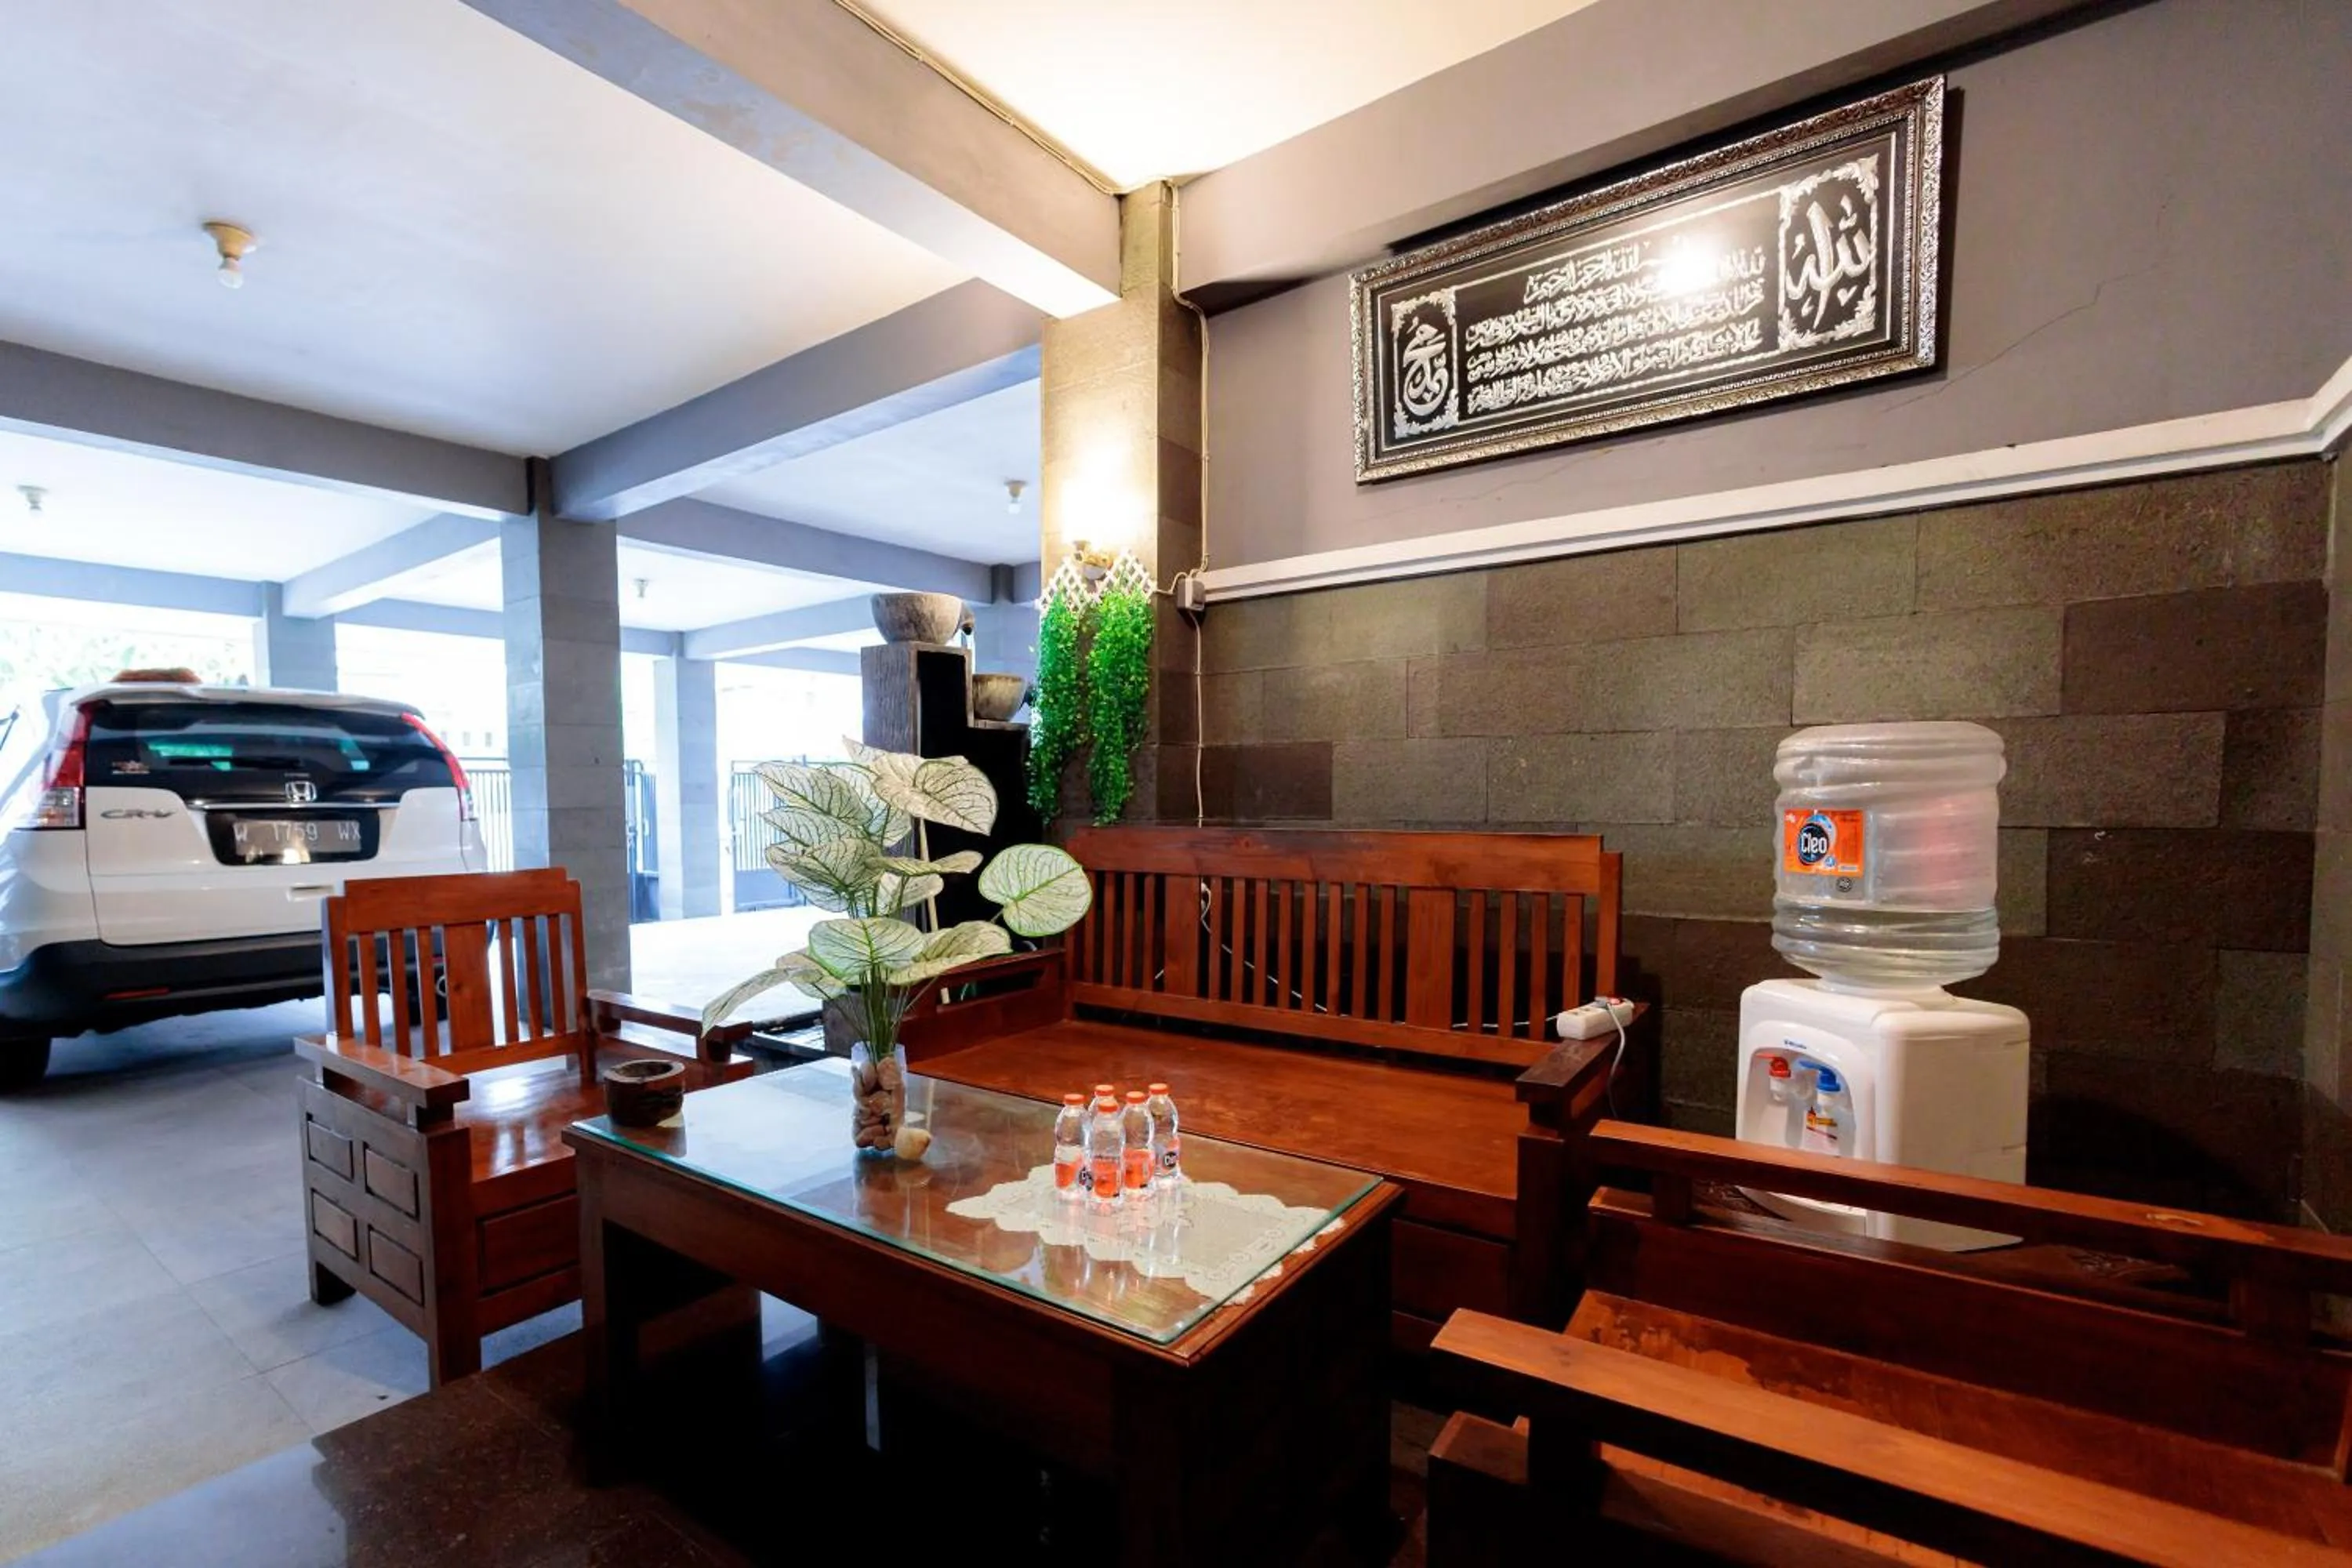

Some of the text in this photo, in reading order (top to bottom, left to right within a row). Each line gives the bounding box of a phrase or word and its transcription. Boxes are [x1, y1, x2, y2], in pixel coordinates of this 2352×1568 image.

[233, 822, 361, 842] W 1759 WX
[1802, 832, 1828, 854] Cleo
